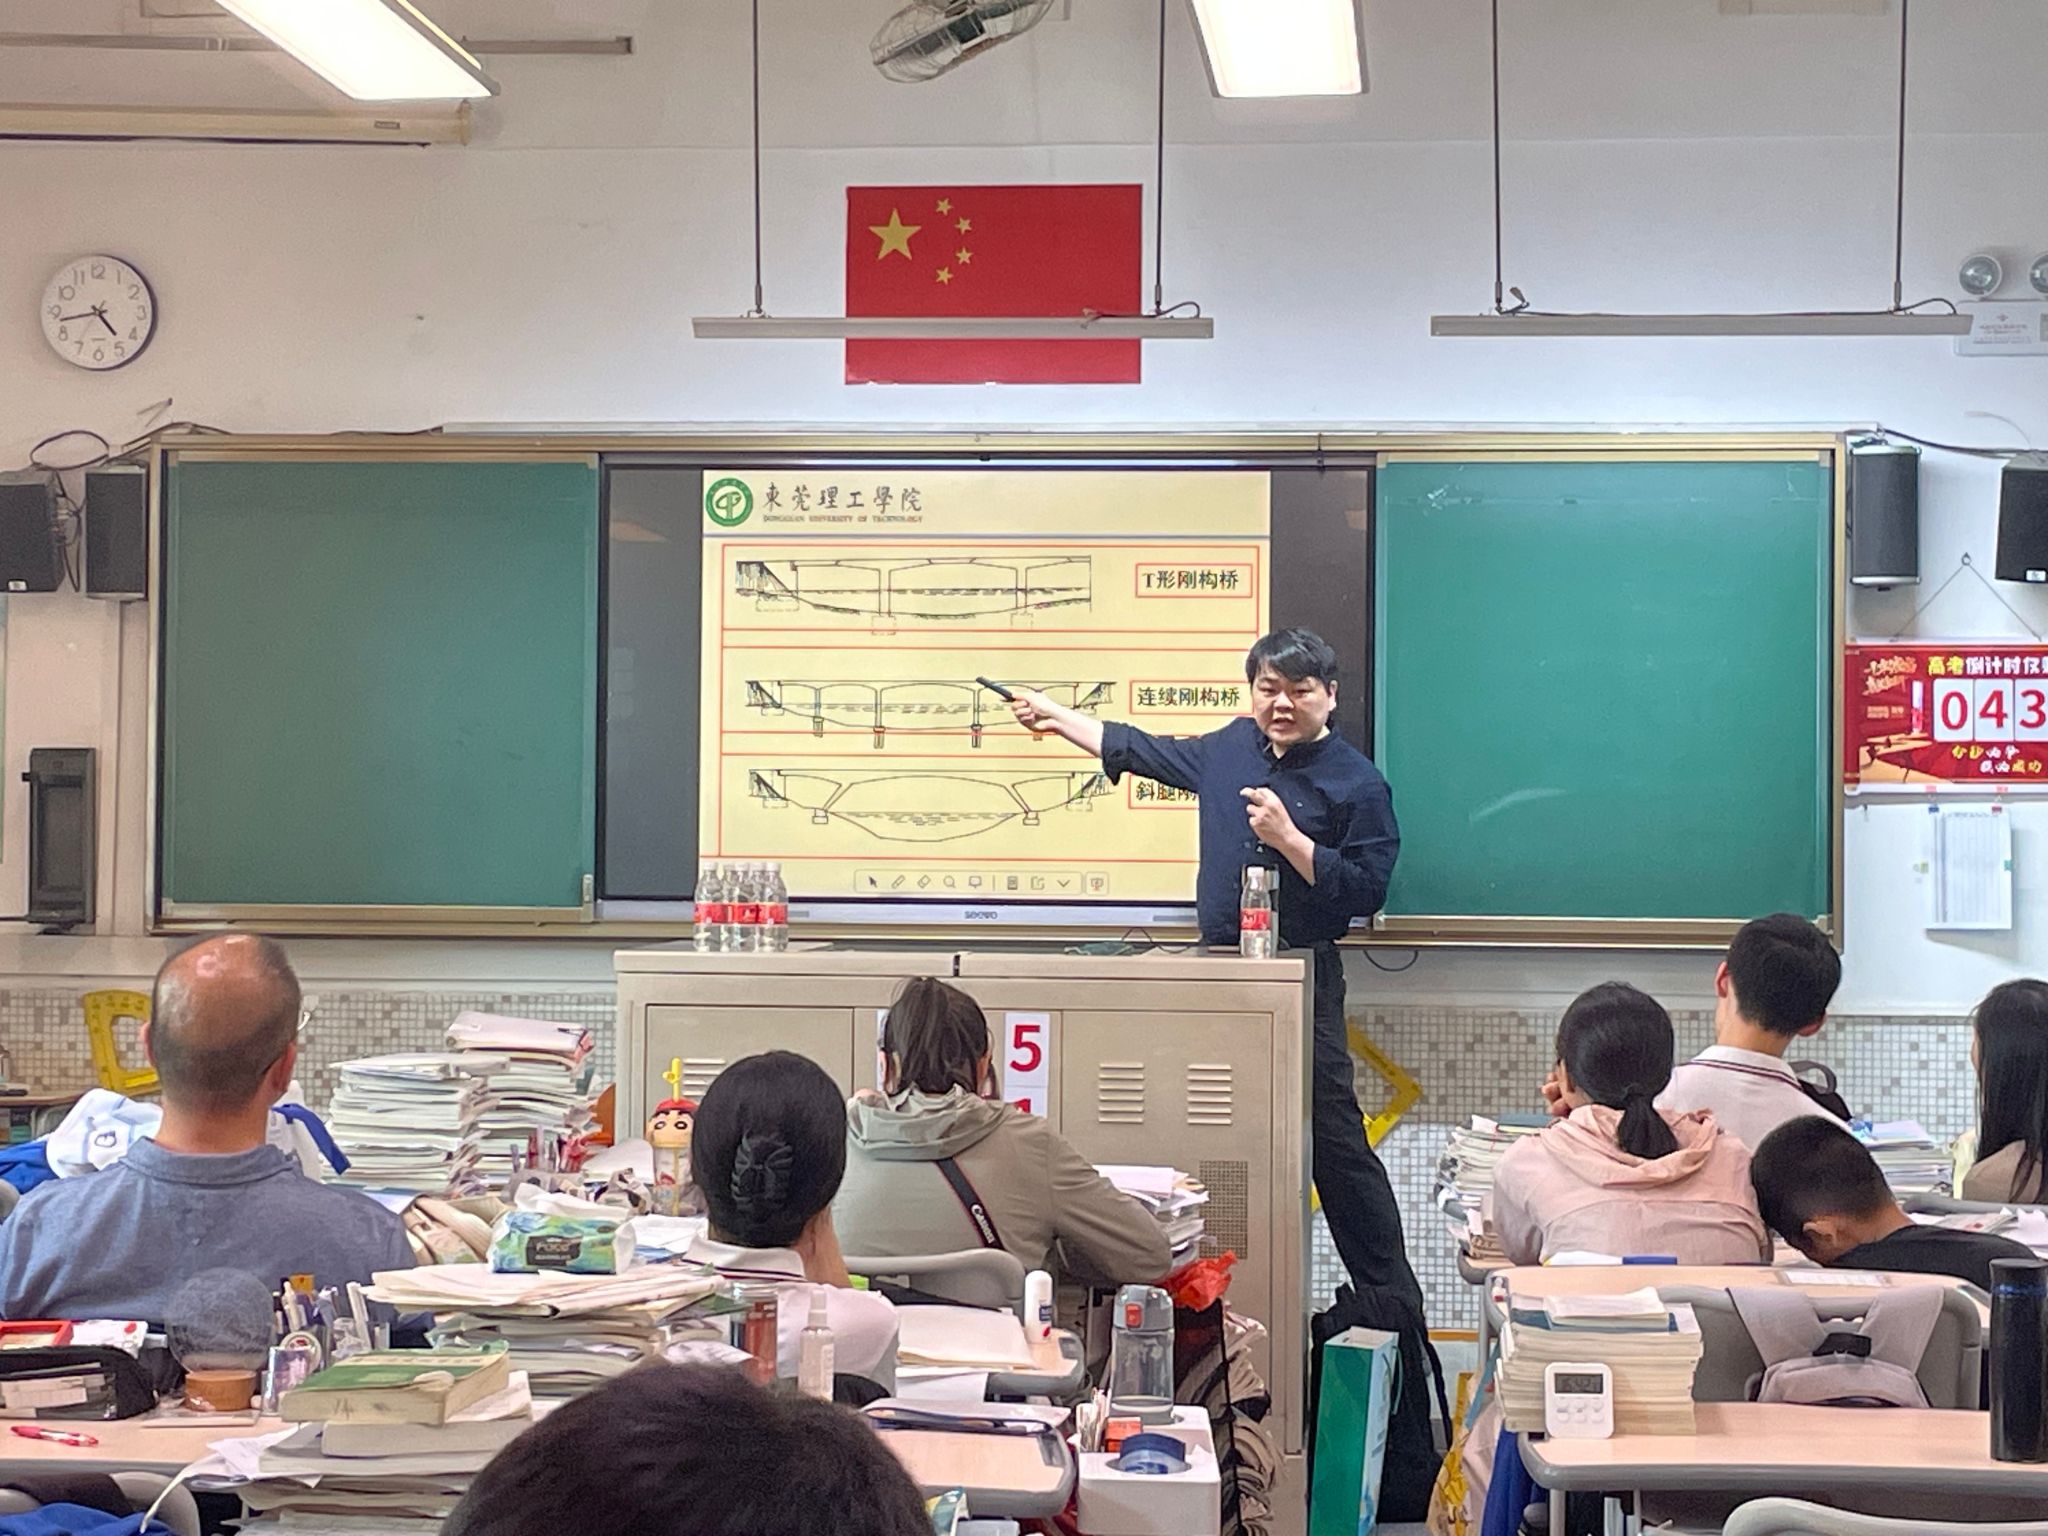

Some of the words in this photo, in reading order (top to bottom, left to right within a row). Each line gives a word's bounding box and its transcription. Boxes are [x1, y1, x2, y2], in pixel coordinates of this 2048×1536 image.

[91, 264, 106, 280] 12
[59, 285, 76, 302] 10
[128, 284, 140, 301] 2
[136, 305, 147, 321] 3
[58, 325, 69, 342] 8
[128, 326, 138, 341] 4
[74, 341, 84, 356] 7
[93, 347, 104, 362] 6
[114, 342, 125, 358] 5
[763, 482, 923, 514] 東莞理工學院
[1142, 569, 1239, 590] T形刚构桥
[1137, 686, 1240, 707] 连续刚构桥
[1940, 688, 2048, 732] 043
[1010, 1024, 1042, 1072] 5
[970, 1203, 996, 1244] Canon
